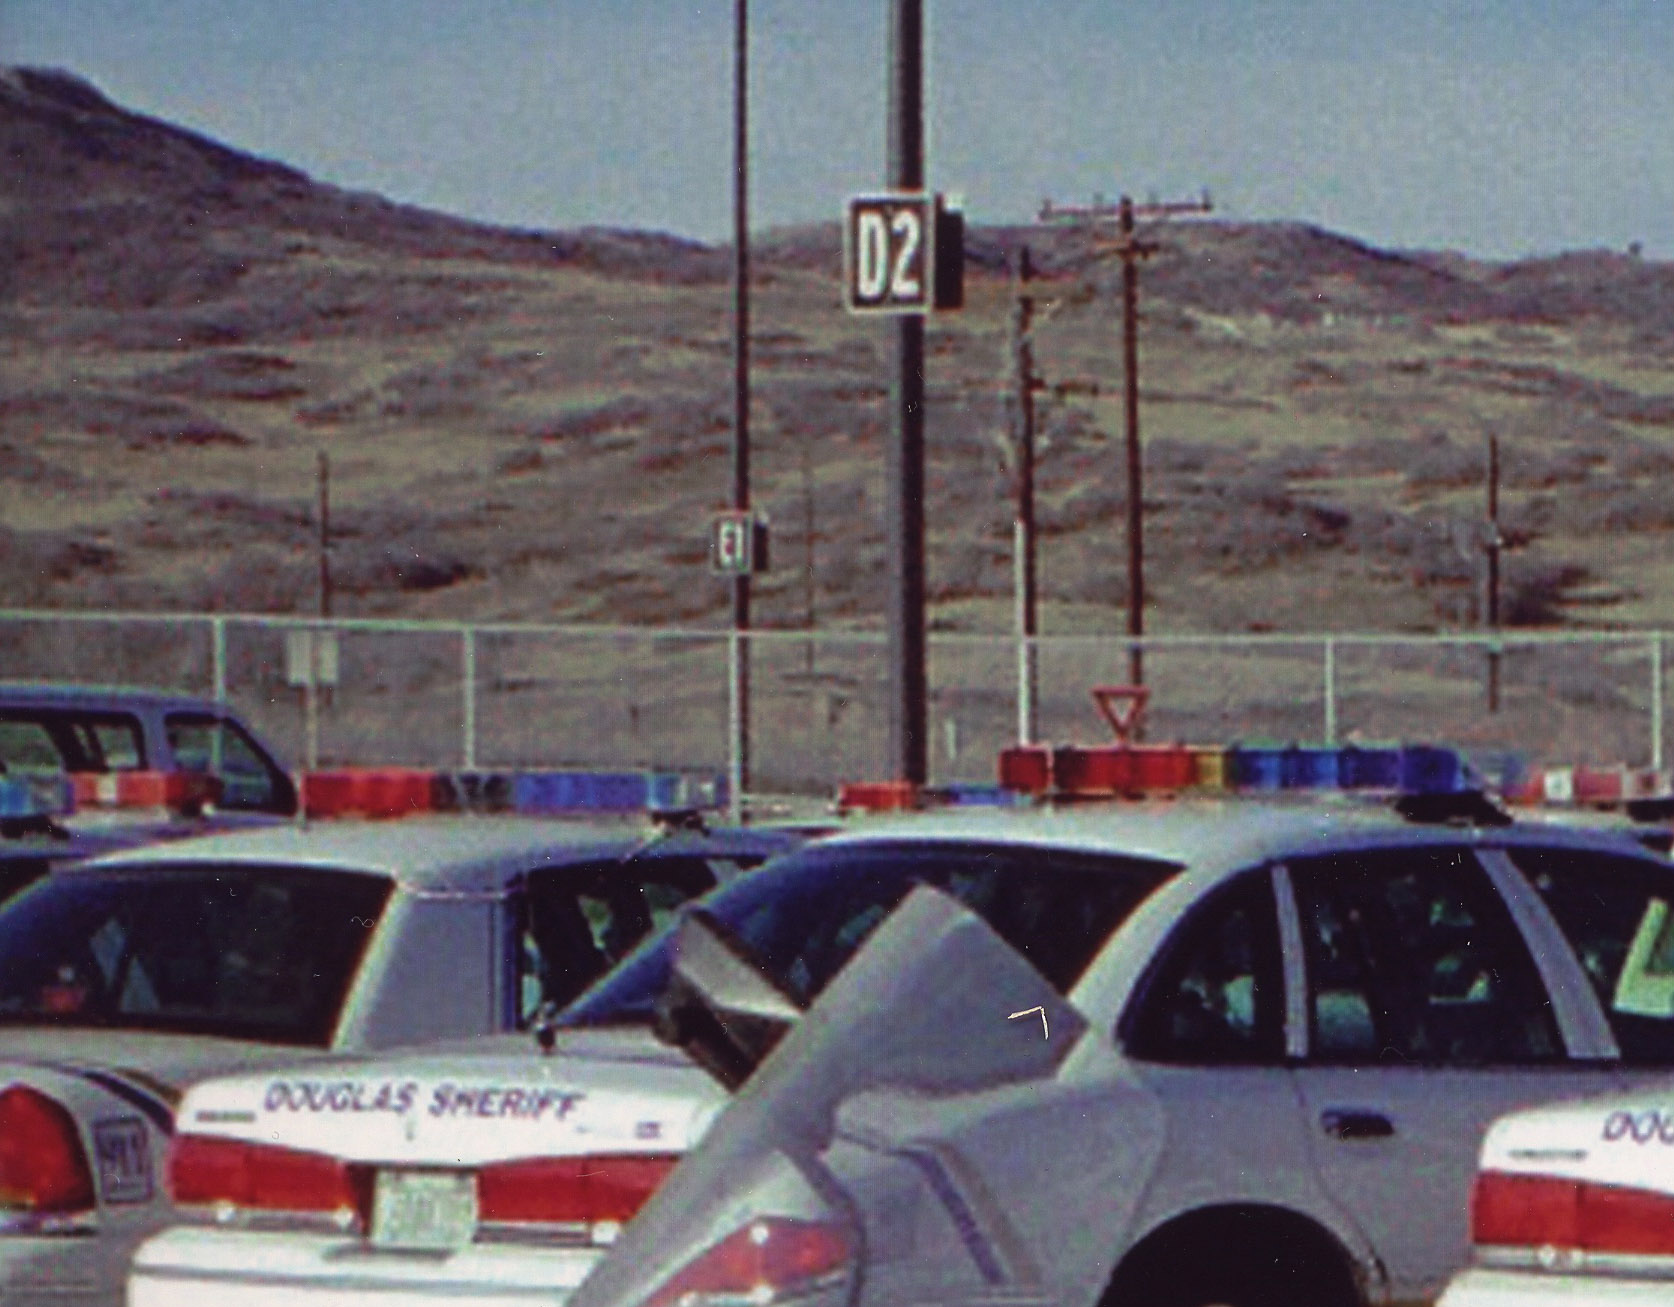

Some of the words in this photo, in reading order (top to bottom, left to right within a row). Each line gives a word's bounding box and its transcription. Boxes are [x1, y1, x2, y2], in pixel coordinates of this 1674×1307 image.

[858, 209, 920, 297] D2
[265, 1081, 417, 1114] DOUGLAS
[427, 1083, 584, 1121] SHERIFF
